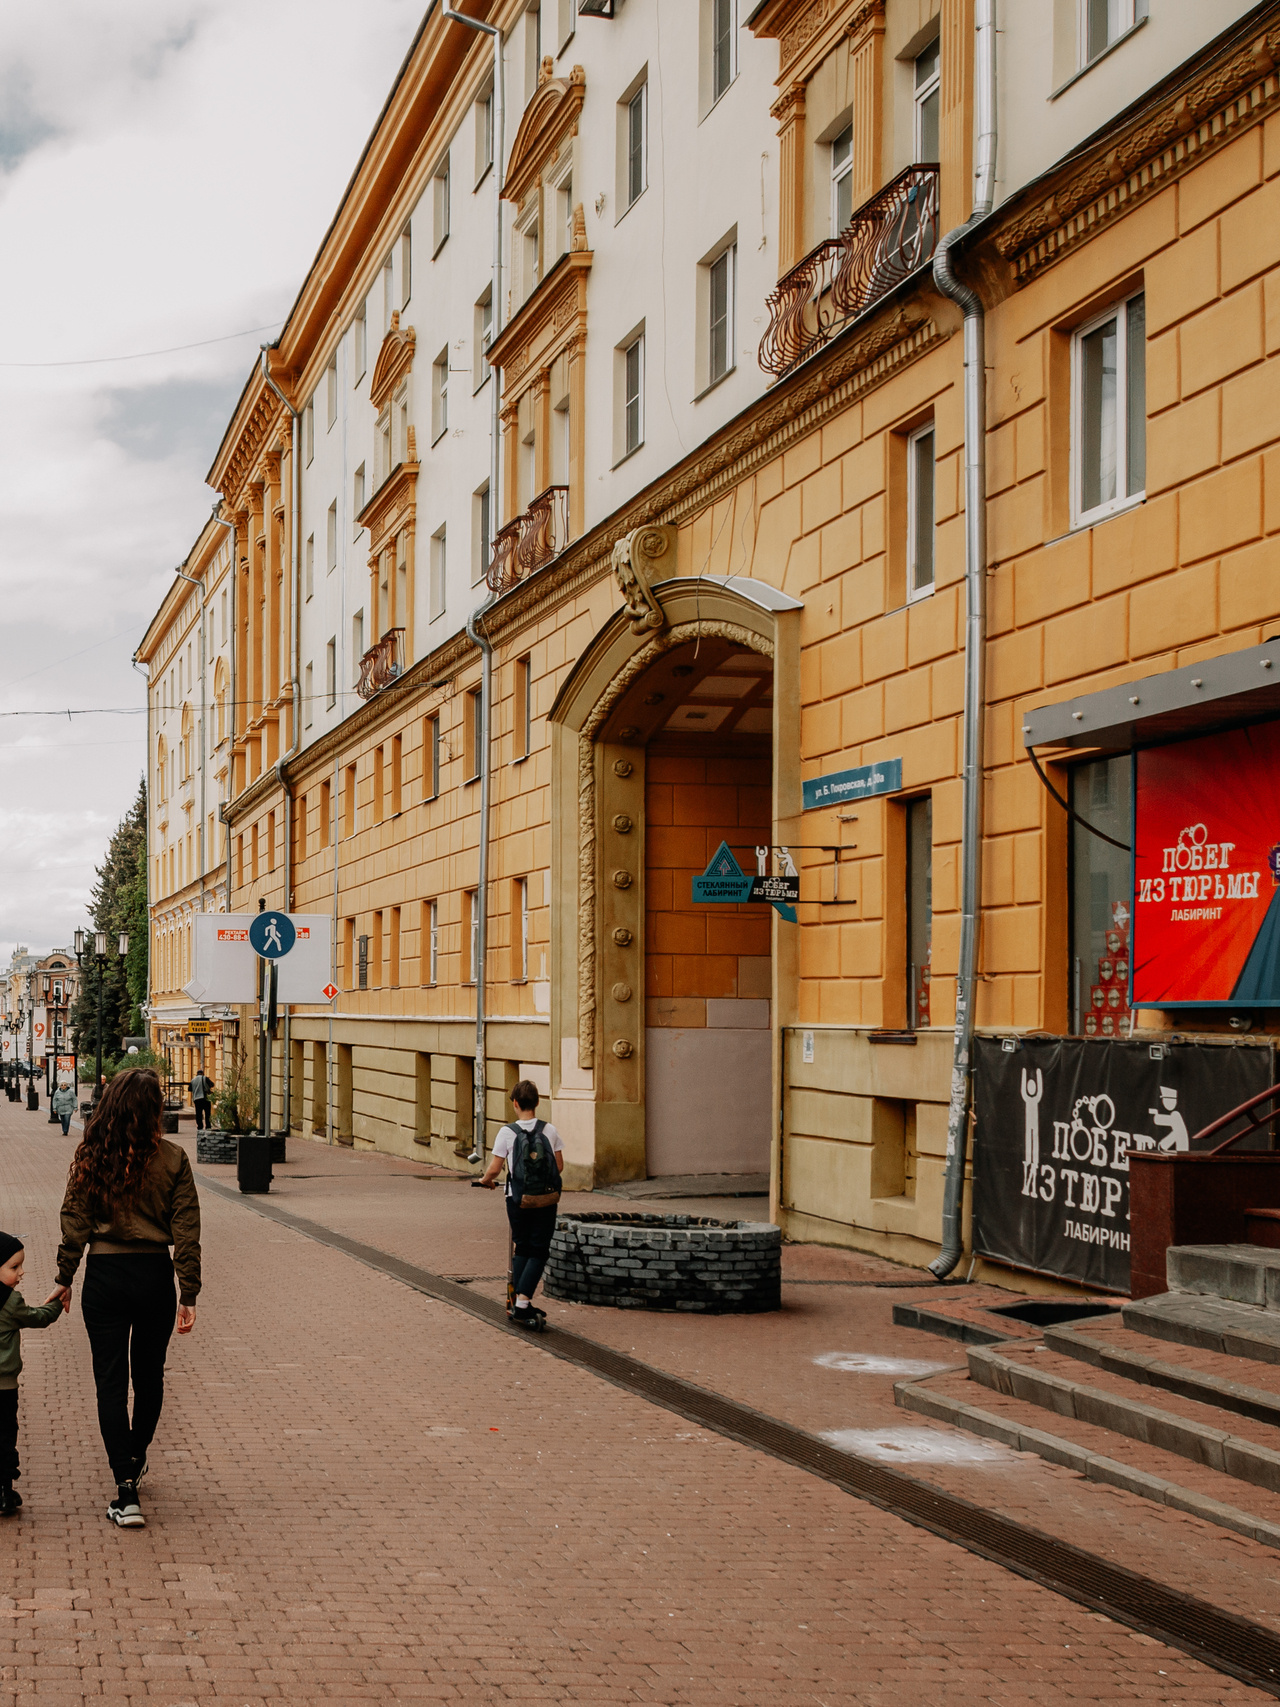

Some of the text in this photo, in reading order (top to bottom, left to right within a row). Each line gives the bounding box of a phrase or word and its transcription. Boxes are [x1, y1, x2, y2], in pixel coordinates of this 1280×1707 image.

[823, 785, 830, 795] Б.
[1162, 843, 1235, 872] ПОБЕГ
[697, 881, 748, 889] СТЕКЛЯННЫЙ
[762, 880, 790, 890] ПОБЕГ
[1138, 872, 1260, 902] ИЗ ТЮРЬМЫ
[702, 889, 743, 897] ЛАБИРИНТ
[753, 887, 798, 898] ИЗ ТЮРЬМЫ
[1171, 907, 1222, 921] ЛАБИРИНТ
[34, 1023, 45, 1037] 9
[3, 1041, 10, 1050] 9
[1021, 1161, 1130, 1220] ИЗ ТЮР
[1064, 1219, 1130, 1252] ЛАБИРИН
